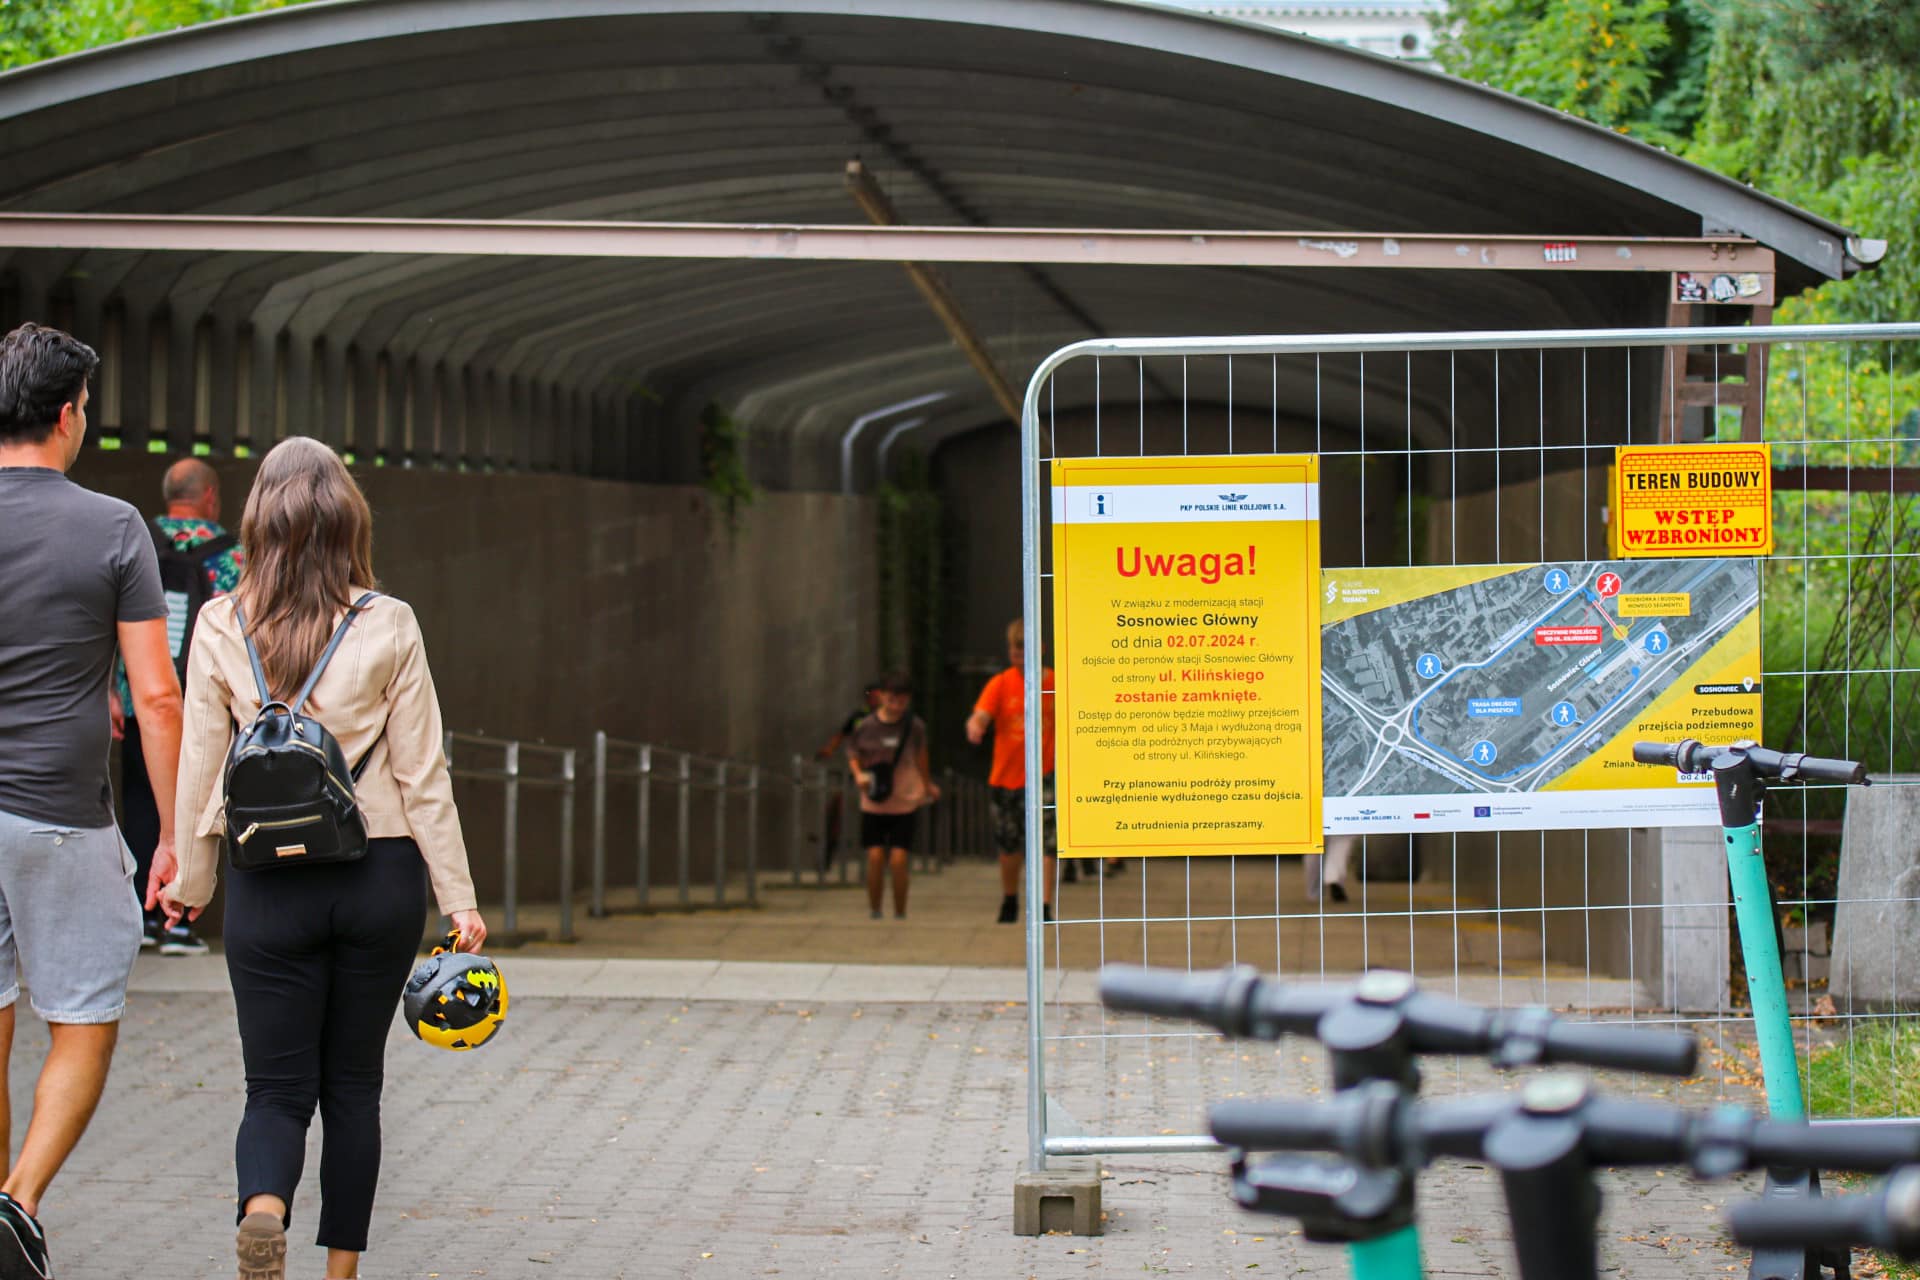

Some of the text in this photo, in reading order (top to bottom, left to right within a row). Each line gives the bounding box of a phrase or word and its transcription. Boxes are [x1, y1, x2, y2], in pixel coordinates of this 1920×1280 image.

[1626, 471, 1761, 490] TEREN BUDOWY
[1239, 503, 1272, 511] KOLEJOWE
[1626, 527, 1763, 545] WZBRONIONY
[1116, 545, 1256, 584] Uwaga!
[1111, 599, 1122, 608] W
[1124, 598, 1162, 610] związku
[1173, 597, 1237, 609] modernizacją
[1239, 597, 1264, 609] stacji
[1116, 613, 1259, 628] Sosnowiec Główny
[1111, 636, 1128, 649] od
[1133, 636, 1163, 648] dnia
[1167, 635, 1245, 648] 02.07.2024
[1082, 653, 1294, 667] dojście do peronów stacji Sosnowiec Główny
[1111, 668, 1265, 685] od strony ul. Kilińskiego
[1547, 664, 1581, 692] Sosnowiec
[1115, 690, 1262, 705] zostanie zamknięte.
[1078, 707, 1299, 723] Dostęp do peronów będzie możliwy przejściem
[1691, 708, 1754, 717] Przebudowa
[1076, 724, 1137, 735] podziemnym
[1142, 723, 1154, 732] od
[1156, 723, 1179, 734] ulicy
[1181, 723, 1188, 732] 3
[1190, 722, 1214, 734] Maja
[1221, 721, 1272, 734] wydłużoną
[1274, 721, 1302, 733] drogą
[1638, 721, 1754, 733] przejścia podziemnego
[1096, 735, 1282, 749] dojścia dla podróżnych przybywających
[1133, 750, 1248, 763] od strony ul. Kilińskiego.
[1603, 760, 1635, 768] Zmiana
[1681, 773, 1693, 781] od
[1701, 771, 1714, 782] lip
[1103, 778, 1276, 790] Przy planowaniu podróży prosimy
[1076, 791, 1303, 805] o uwzględnienie wydłużonego czasu dojścia.
[1115, 820, 1265, 831] Za utrudnienia przepraszamy.
